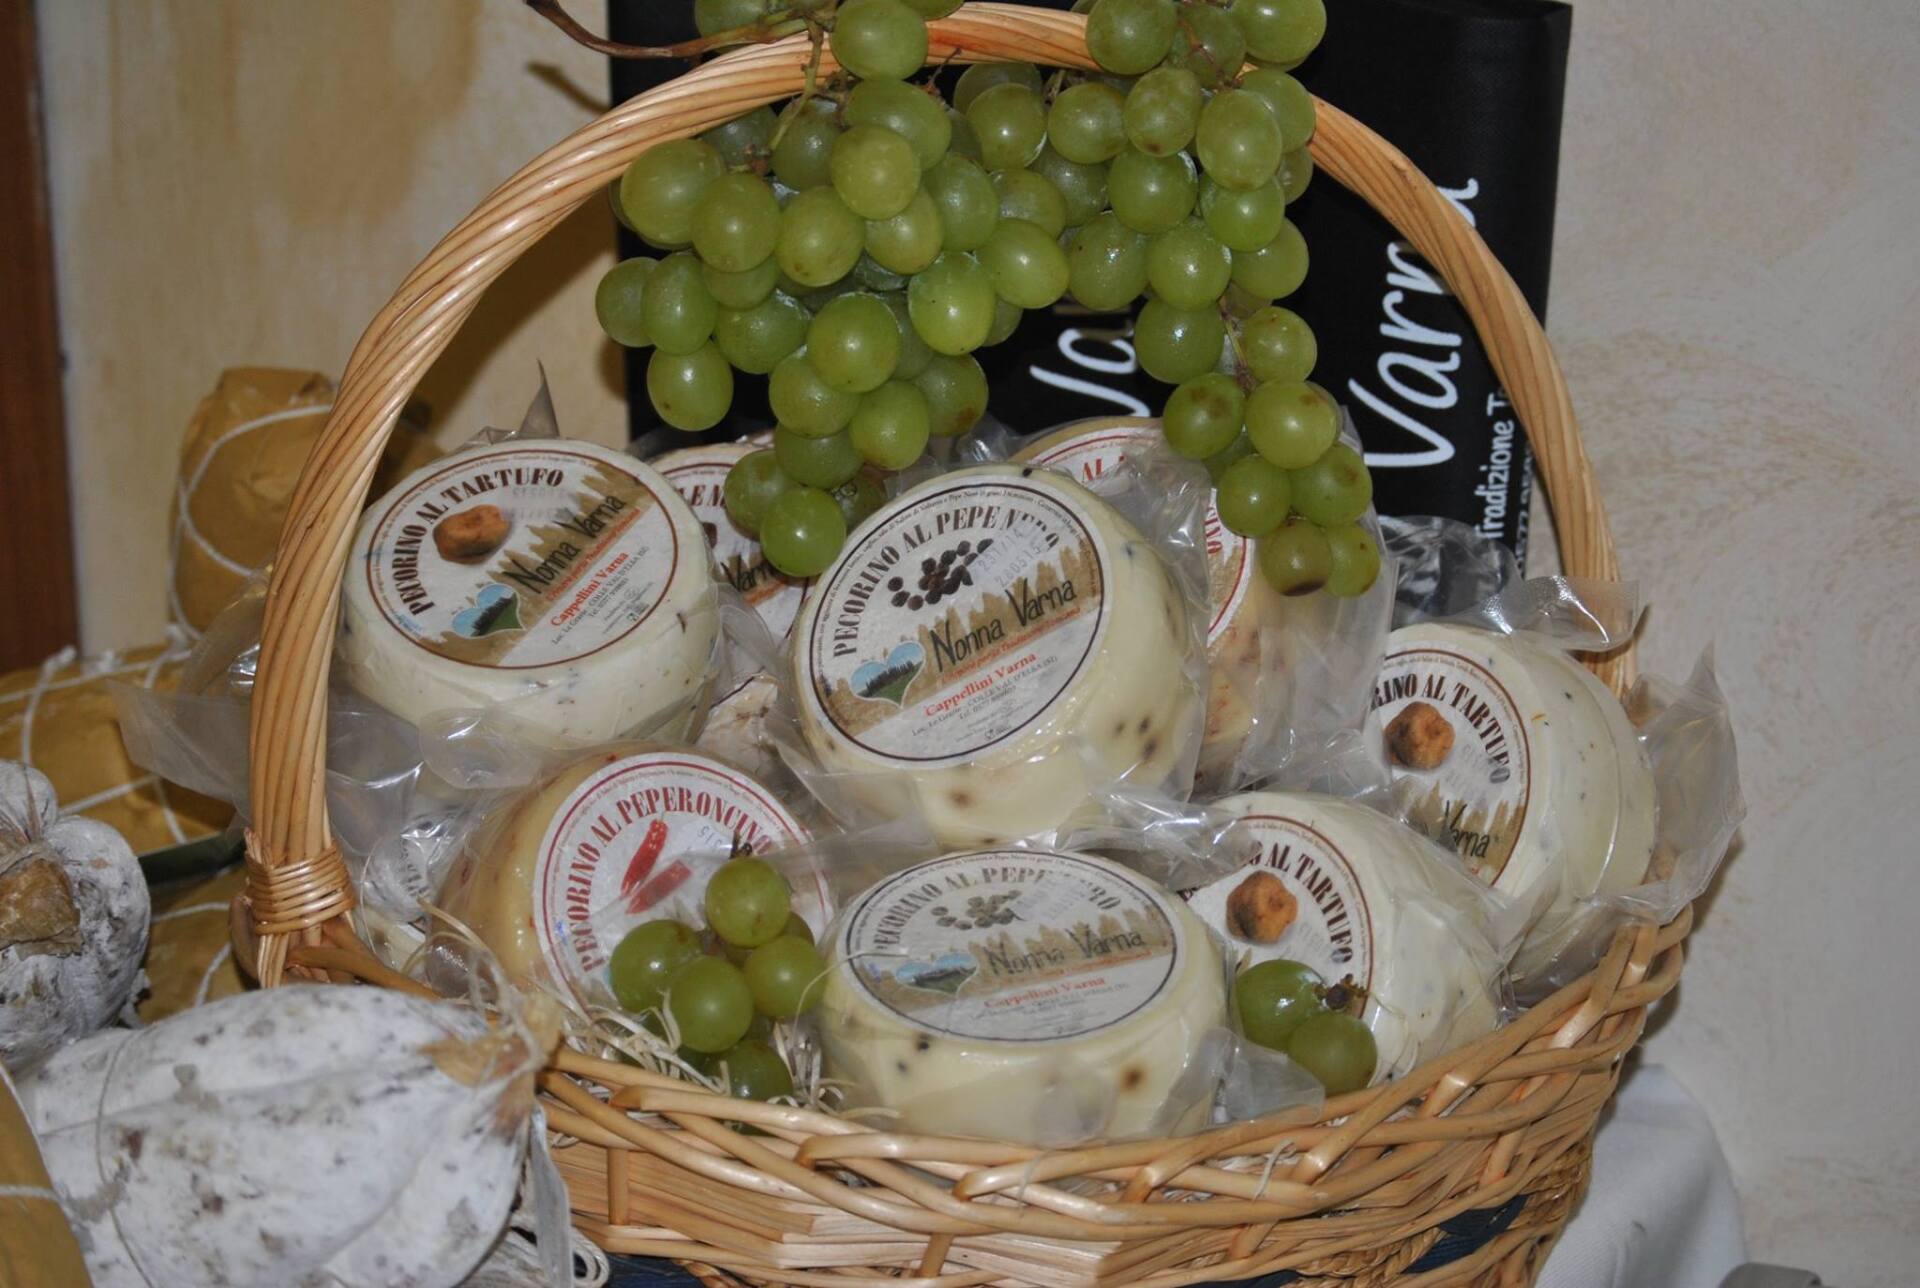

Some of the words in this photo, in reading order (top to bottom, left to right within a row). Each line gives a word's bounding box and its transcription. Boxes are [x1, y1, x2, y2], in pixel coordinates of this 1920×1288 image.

[1474, 419, 1515, 540] Tradizione
[392, 524, 435, 615] PECORINO
[416, 502, 449, 525] AL
[440, 468, 564, 504] TARTUFO
[502, 541, 582, 594] Nonna
[552, 495, 627, 538] Varna
[551, 579, 602, 626] Cappellini
[595, 552, 629, 579] Varna
[833, 545, 900, 658] PECORINO
[902, 523, 932, 553] AL
[936, 505, 1001, 535] PEPE
[1001, 508, 1060, 551] NO
[928, 616, 1005, 672] Nonna
[1005, 577, 1078, 628] Varna
[924, 673, 993, 717] Cappellini
[994, 652, 1037, 678] Varna
[1421, 674, 1447, 701] AL
[1450, 682, 1511, 784] TARTUFO
[566, 842, 606, 973] PECORINO
[590, 815, 623, 845] AL
[616, 787, 772, 854] PEPERONCINO
[873, 883, 942, 949] ECORINO
[945, 872, 978, 889] AL
[1265, 842, 1291, 873] AL
[1294, 852, 1353, 963] TARTUFO
[983, 941, 1065, 976] Nonna
[1065, 923, 1146, 958] Varna
